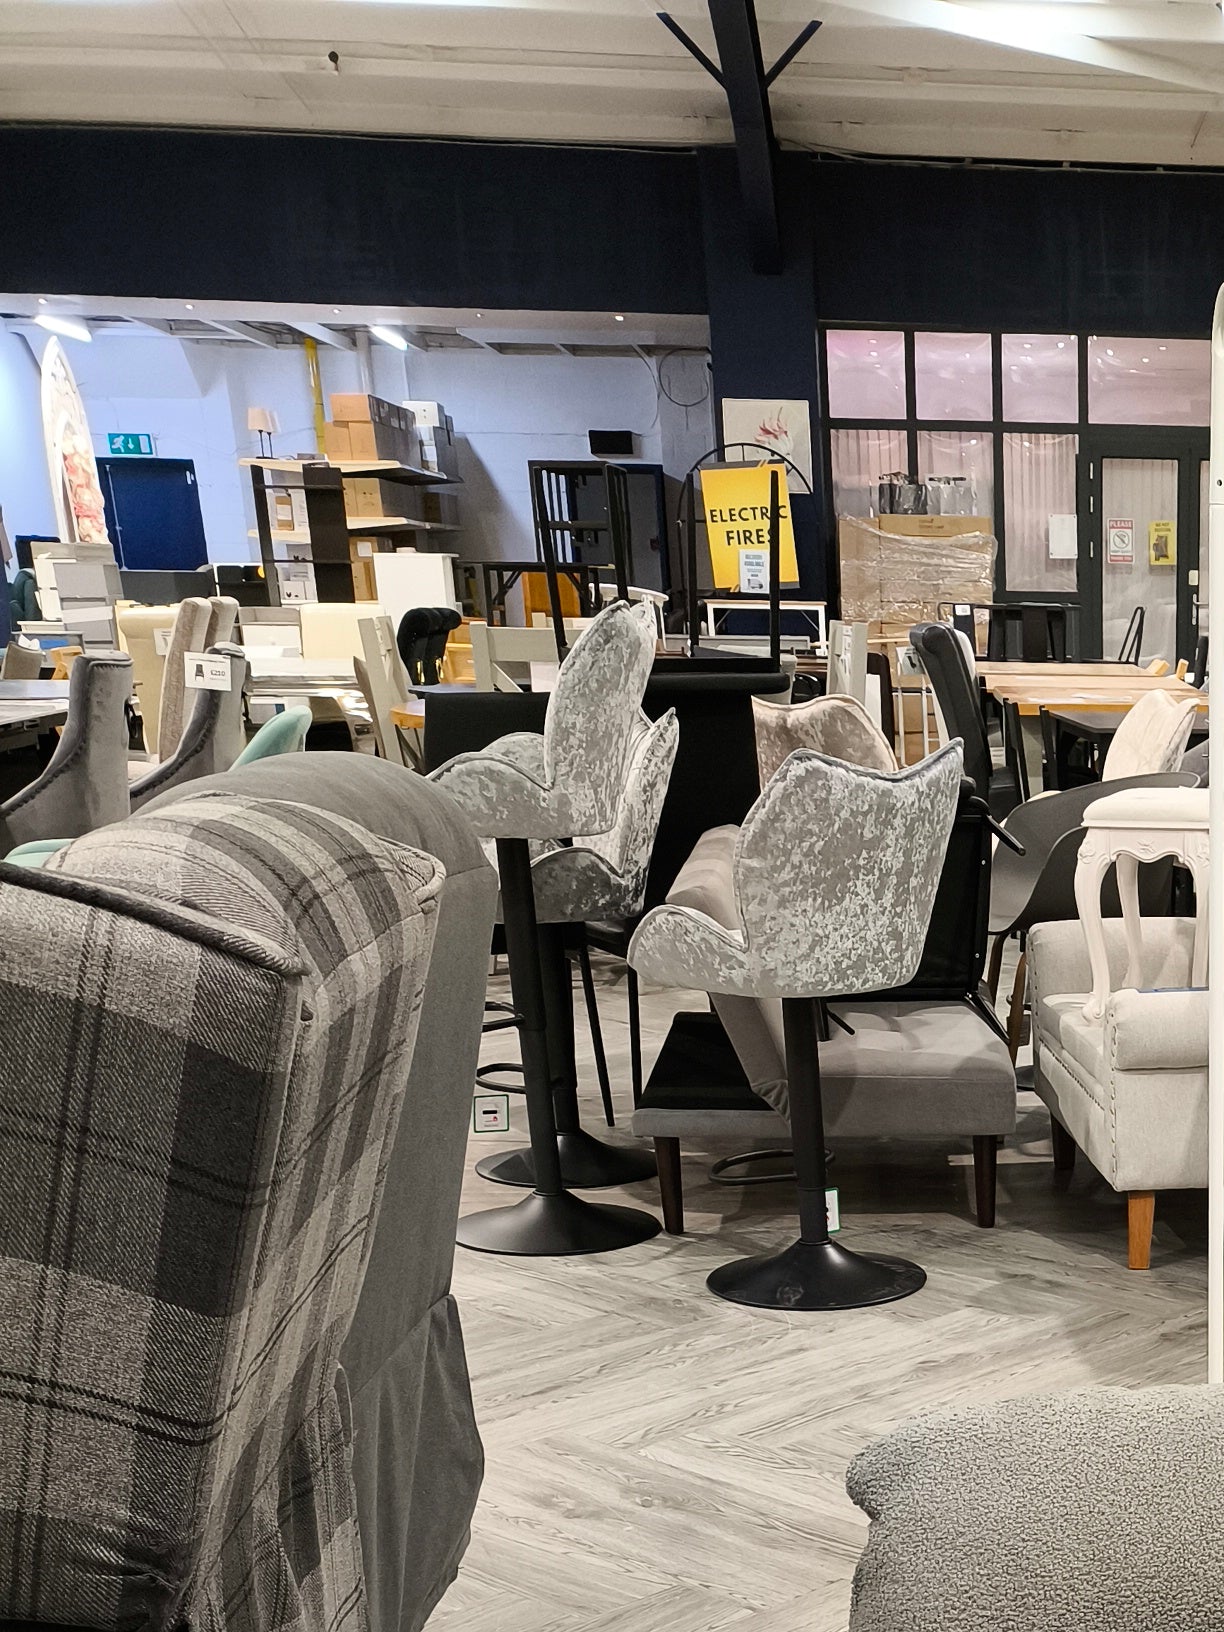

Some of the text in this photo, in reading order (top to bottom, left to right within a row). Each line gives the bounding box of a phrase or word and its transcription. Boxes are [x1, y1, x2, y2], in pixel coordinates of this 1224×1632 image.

[709, 505, 788, 523] ELECTRC
[1109, 520, 1132, 528] PLEASE
[725, 528, 771, 546] FIRE
